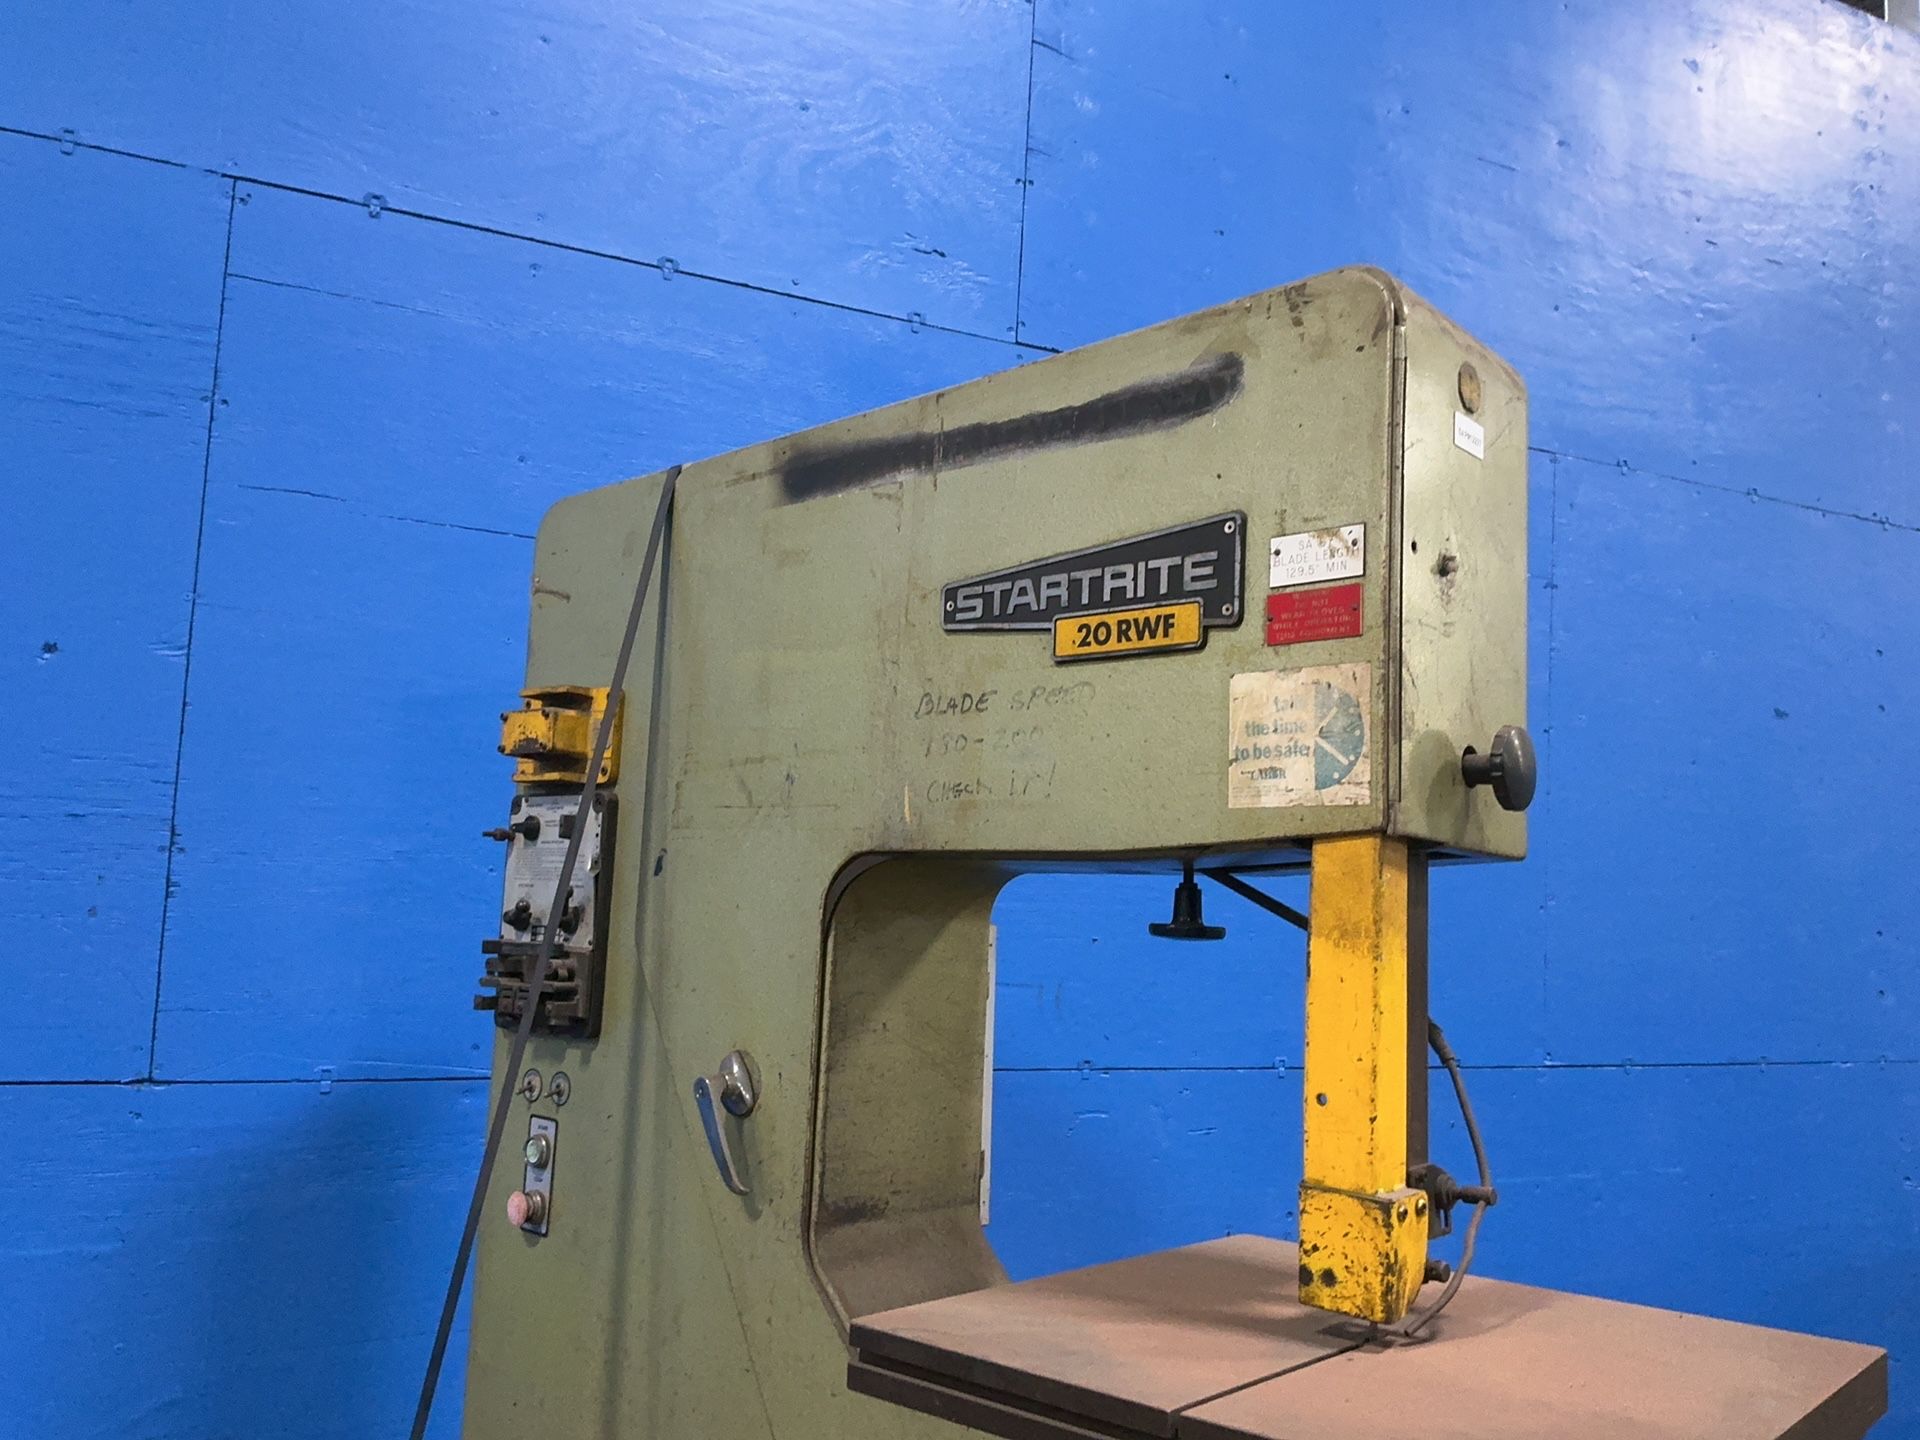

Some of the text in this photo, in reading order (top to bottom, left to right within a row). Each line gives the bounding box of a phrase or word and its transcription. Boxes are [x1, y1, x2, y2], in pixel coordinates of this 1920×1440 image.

[1273, 547, 1360, 567] BLADE LENGTH
[1326, 560, 1347, 573] MIN
[955, 551, 1218, 621] STARTRITE
[1076, 613, 1176, 648] 20 RWF
[914, 690, 998, 720] BLADE
[1244, 719, 1270, 737] the
[1234, 744, 1250, 762] to
[1252, 742, 1272, 759] be
